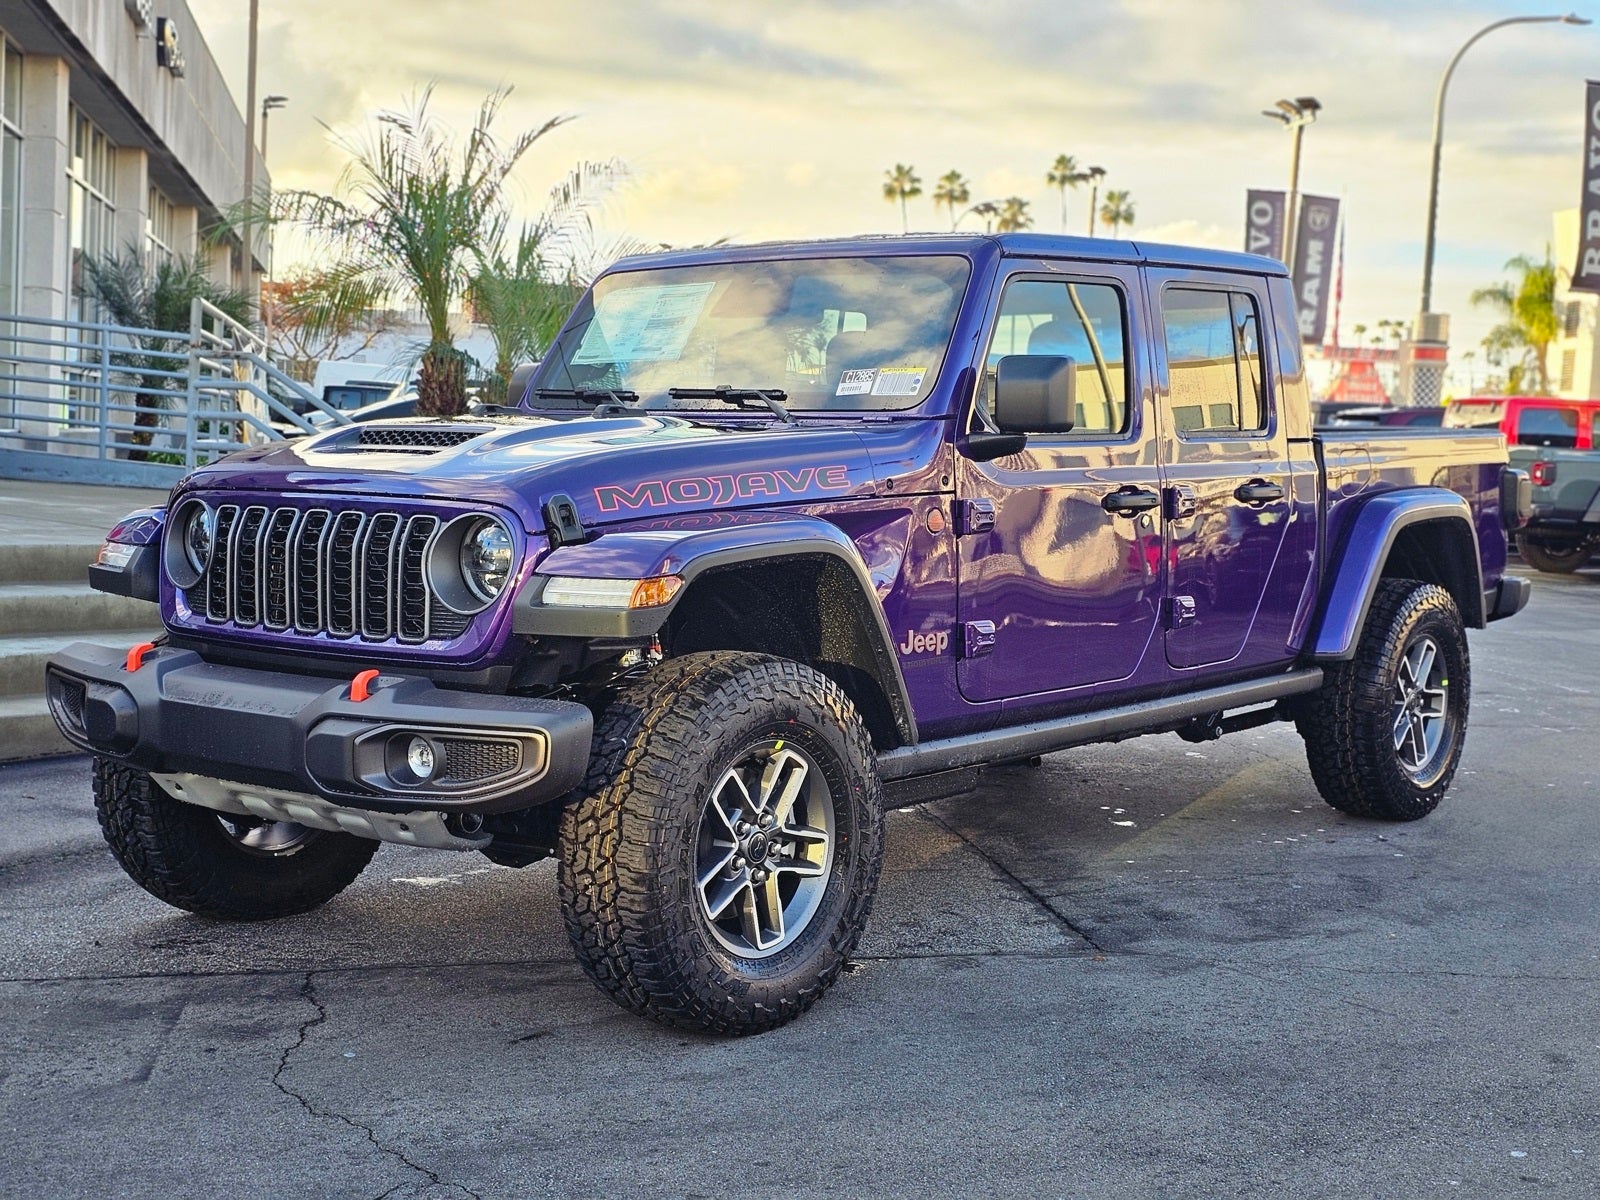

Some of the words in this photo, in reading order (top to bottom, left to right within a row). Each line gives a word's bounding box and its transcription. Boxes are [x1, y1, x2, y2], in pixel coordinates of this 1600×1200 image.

[1250, 200, 1273, 256] VO
[1299, 240, 1324, 336] RAM
[594, 465, 850, 511] MOJAVE
[900, 630, 948, 655] Jeep
